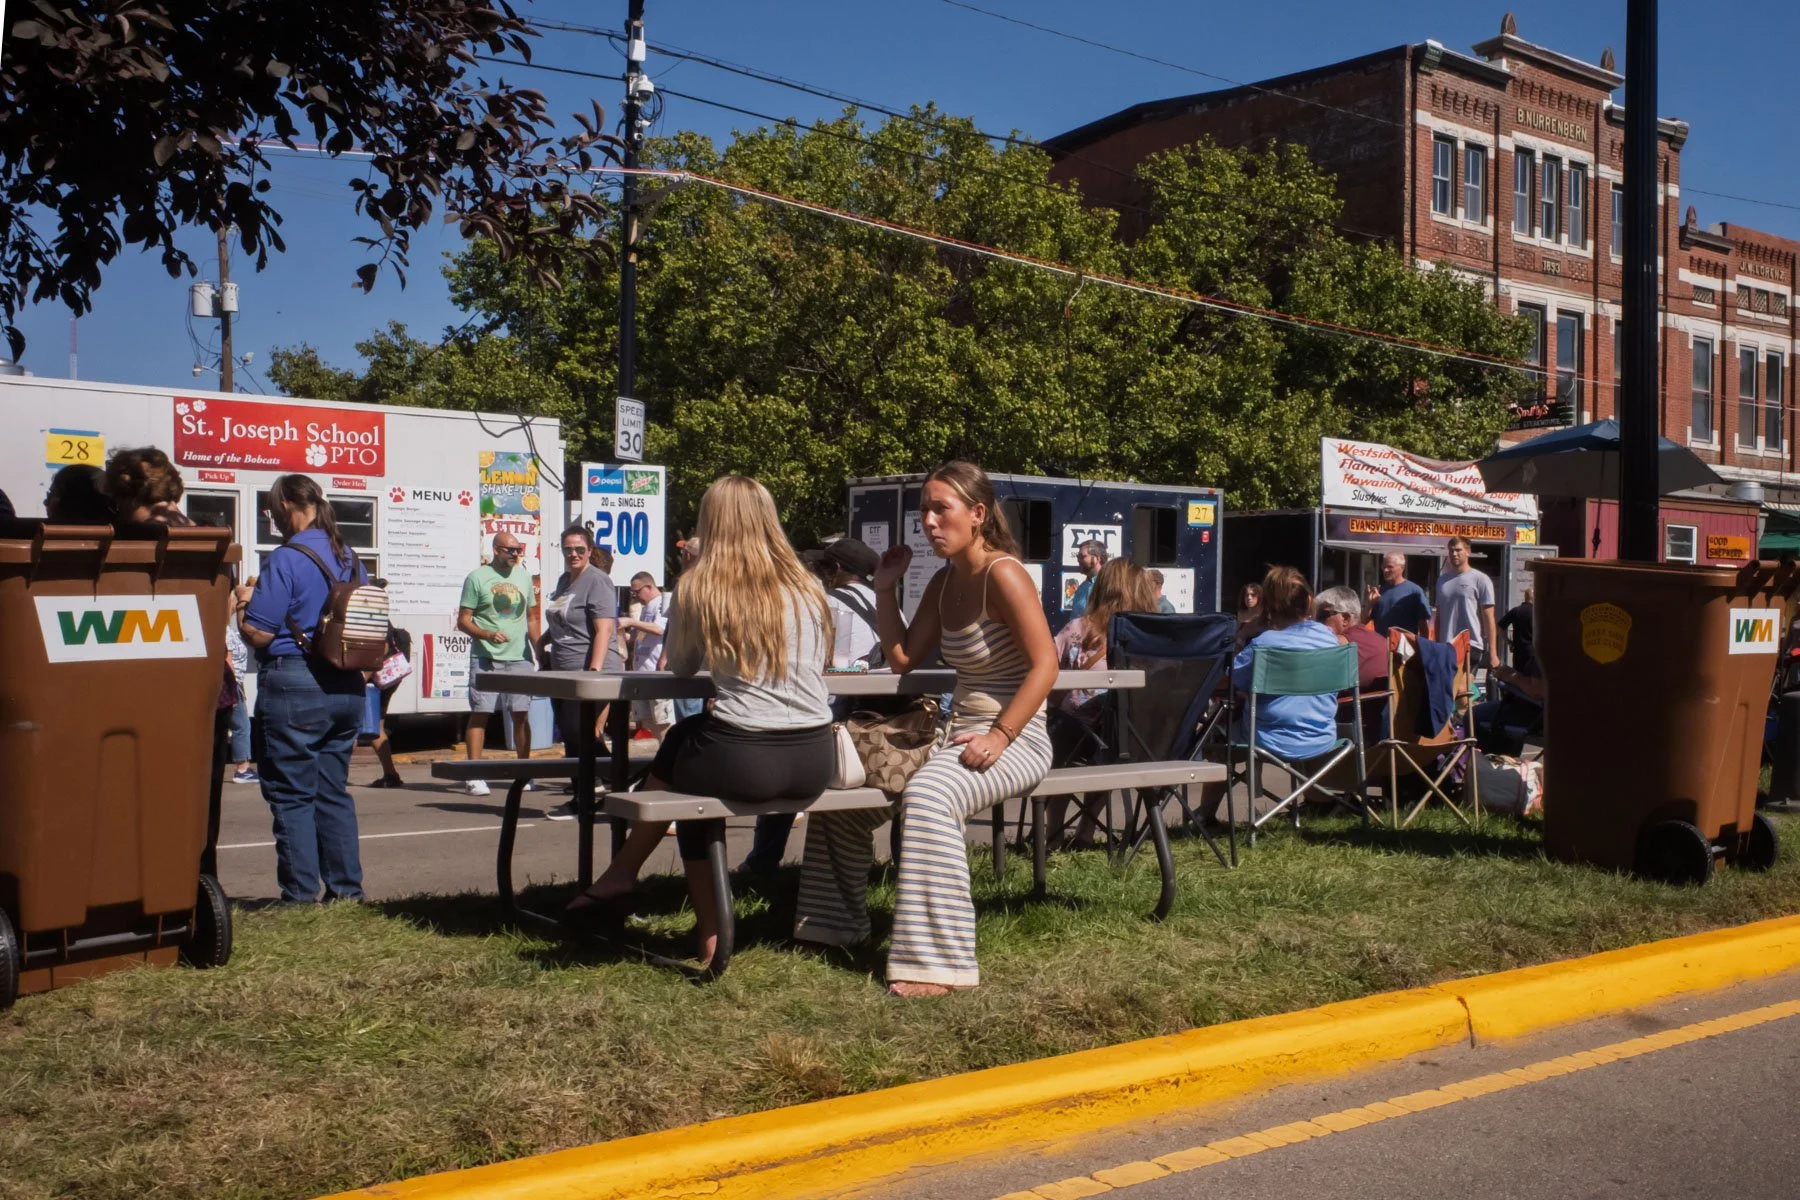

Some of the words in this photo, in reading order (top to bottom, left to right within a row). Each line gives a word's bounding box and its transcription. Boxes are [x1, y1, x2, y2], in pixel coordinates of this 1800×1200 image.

[622, 417, 642, 428] LIMIT
[182, 414, 214, 436] St.
[220, 417, 299, 446] Joseph
[306, 422, 380, 446] School
[620, 430, 642, 454] 30
[61, 440, 89, 460] 28
[331, 446, 378, 466] PTO
[1336, 443, 1399, 459] Westside
[183, 451, 212, 462] Home
[214, 453, 226, 465] of
[227, 453, 242, 463] the
[244, 455, 281, 465] Bobcats
[205, 472, 218, 480] Pick
[220, 473, 230, 482] Up
[333, 479, 350, 488] Order
[480, 470, 537, 486] LEMON
[601, 478, 622, 486] pepsi
[1343, 473, 1403, 492] Hawaiian
[1444, 473, 1482, 485] Butter
[412, 490, 452, 501] MENU
[482, 484, 534, 496] SHAKE-UP
[601, 497, 609, 507] 20
[618, 497, 645, 508] SINGLES
[1352, 489, 1388, 505] Slushies
[1399, 494, 1414, 508] Ski
[1194, 506, 1208, 520] 27
[484, 519, 537, 535] KETTLE
[1351, 519, 1396, 532] EVANSVILLE
[1398, 521, 1453, 535] PROFESSIONAL
[1455, 524, 1471, 536] FIRE
[1472, 525, 1506, 537] FIGHTERS
[1520, 530, 1532, 542] 26
[1709, 536, 1729, 546] GOOD
[57, 609, 184, 645] WM
[1735, 618, 1774, 643] WM
[438, 635, 473, 645] THANK
[444, 644, 467, 653] YOU
